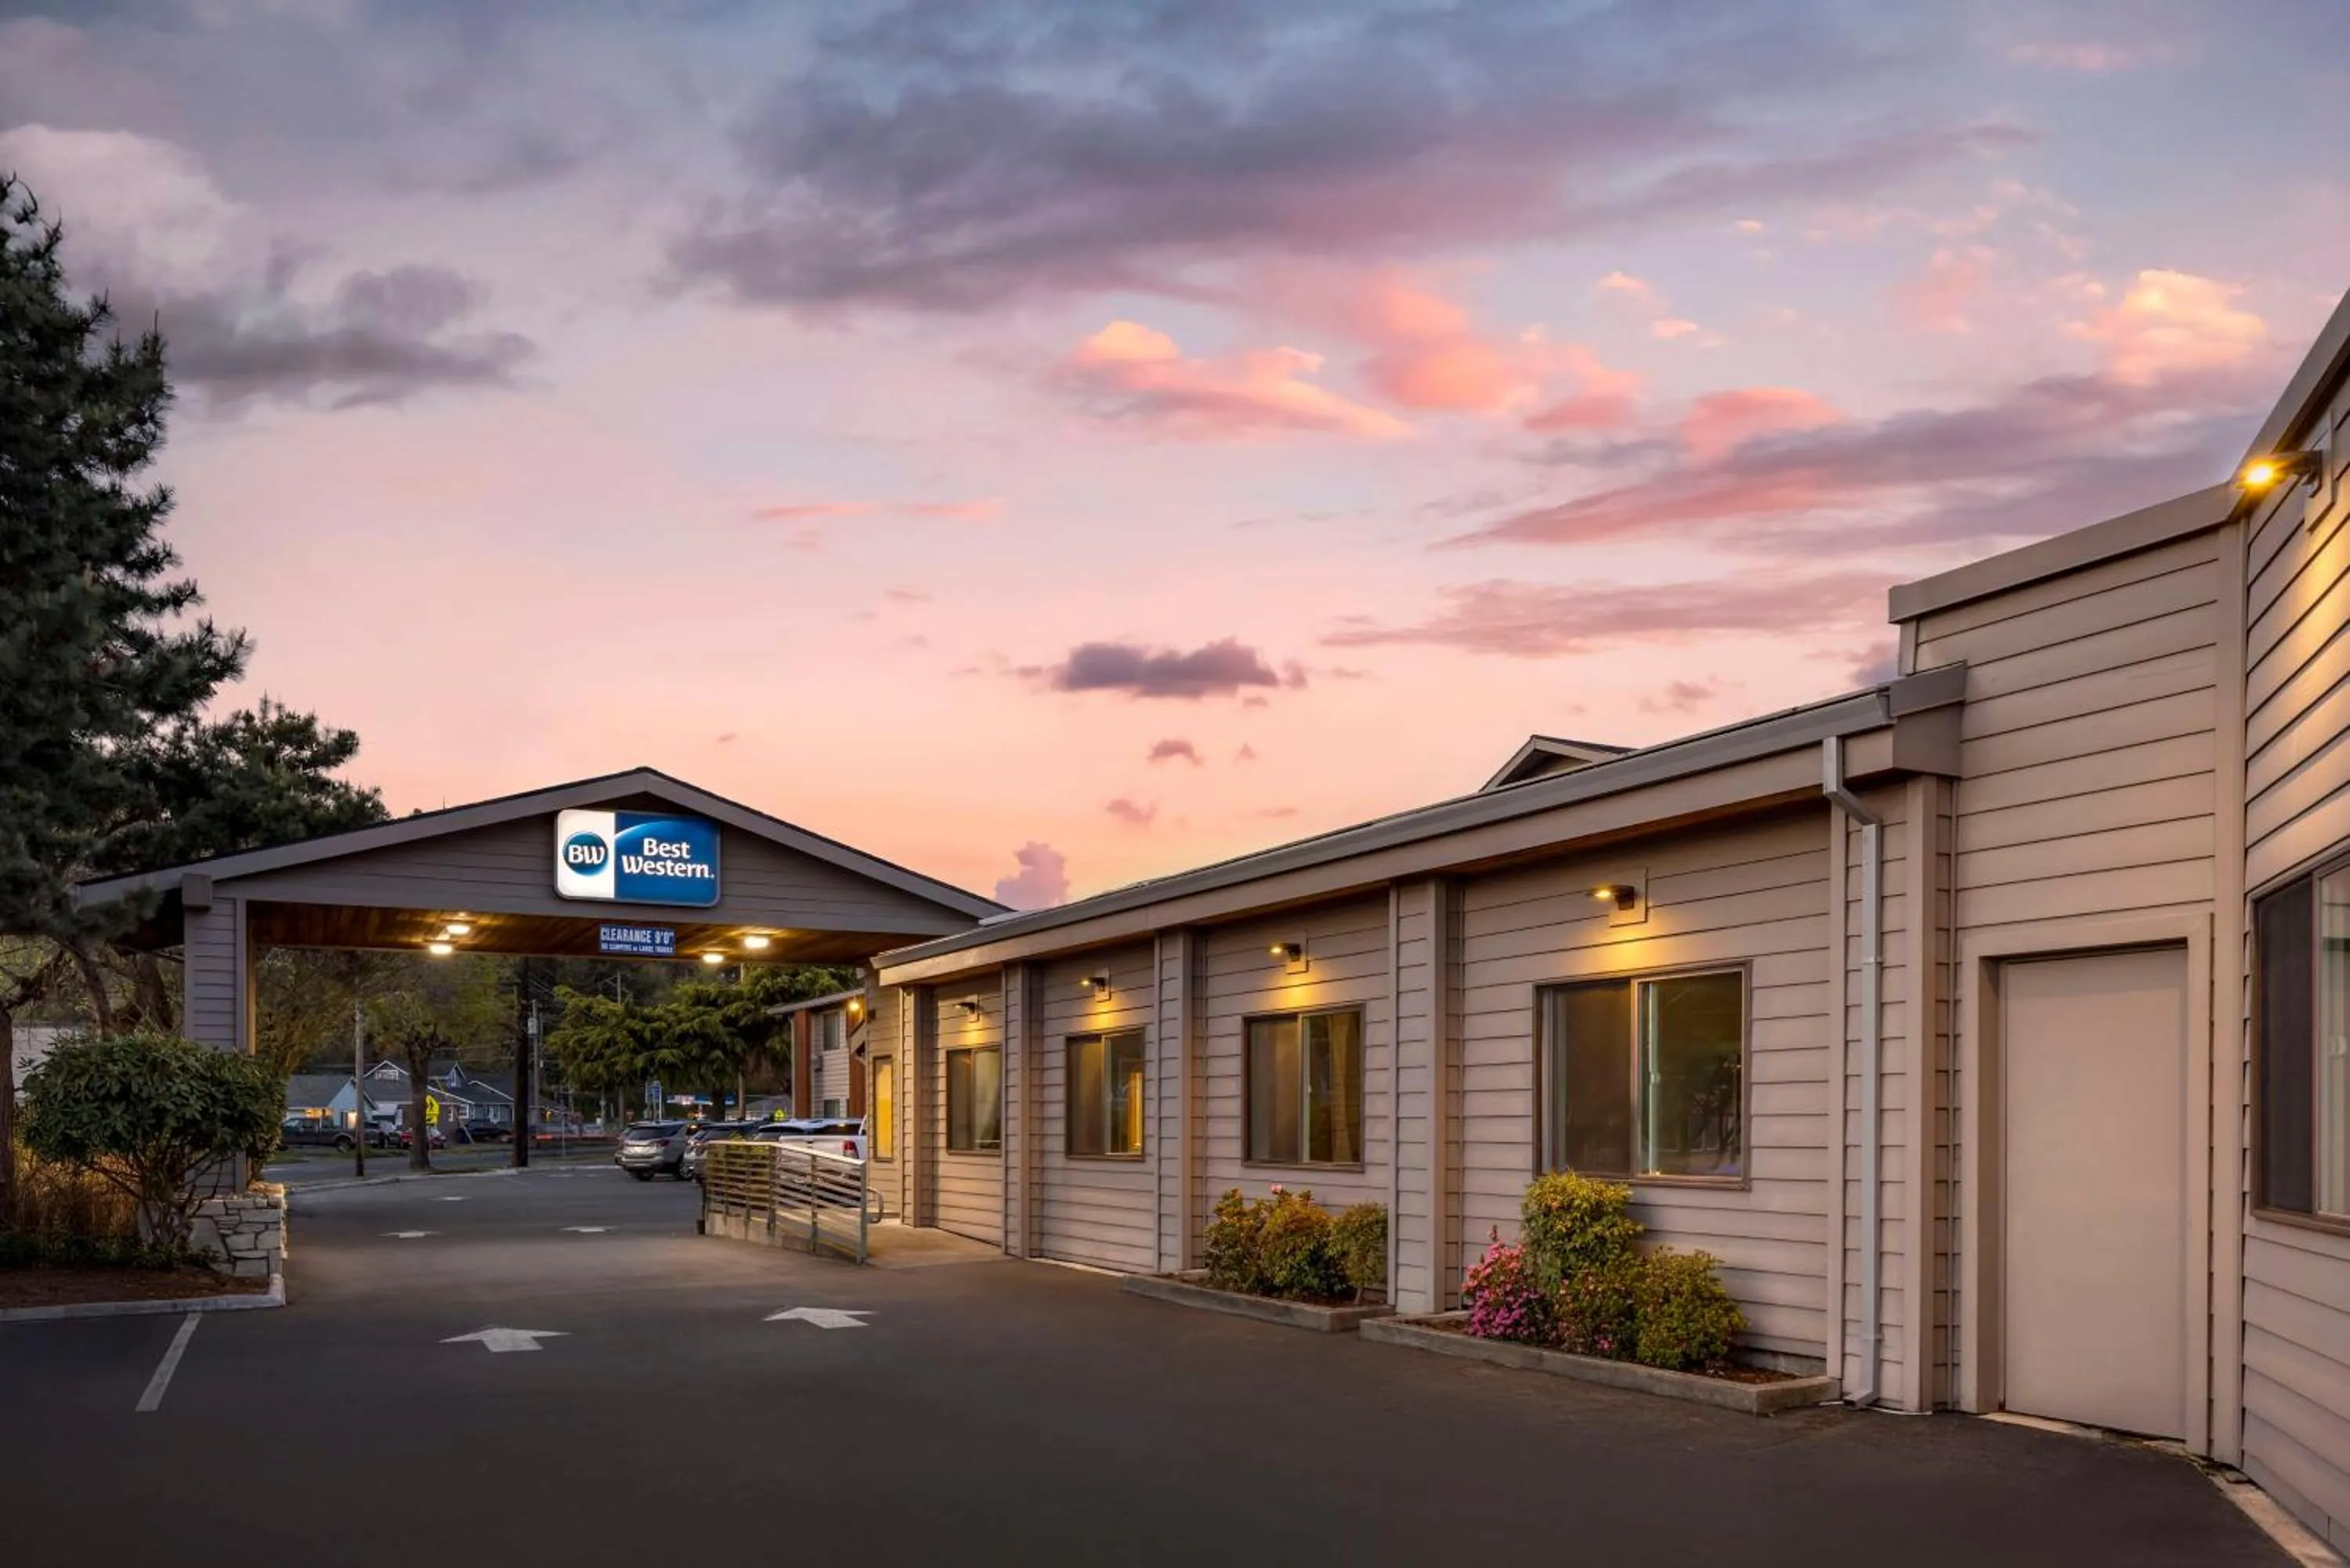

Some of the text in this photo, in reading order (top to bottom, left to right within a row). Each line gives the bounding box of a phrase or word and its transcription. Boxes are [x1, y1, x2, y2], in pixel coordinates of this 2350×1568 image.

[568, 845, 605, 865] BW
[643, 837, 690, 859] Best
[601, 927, 652, 943] CLEARANCE
